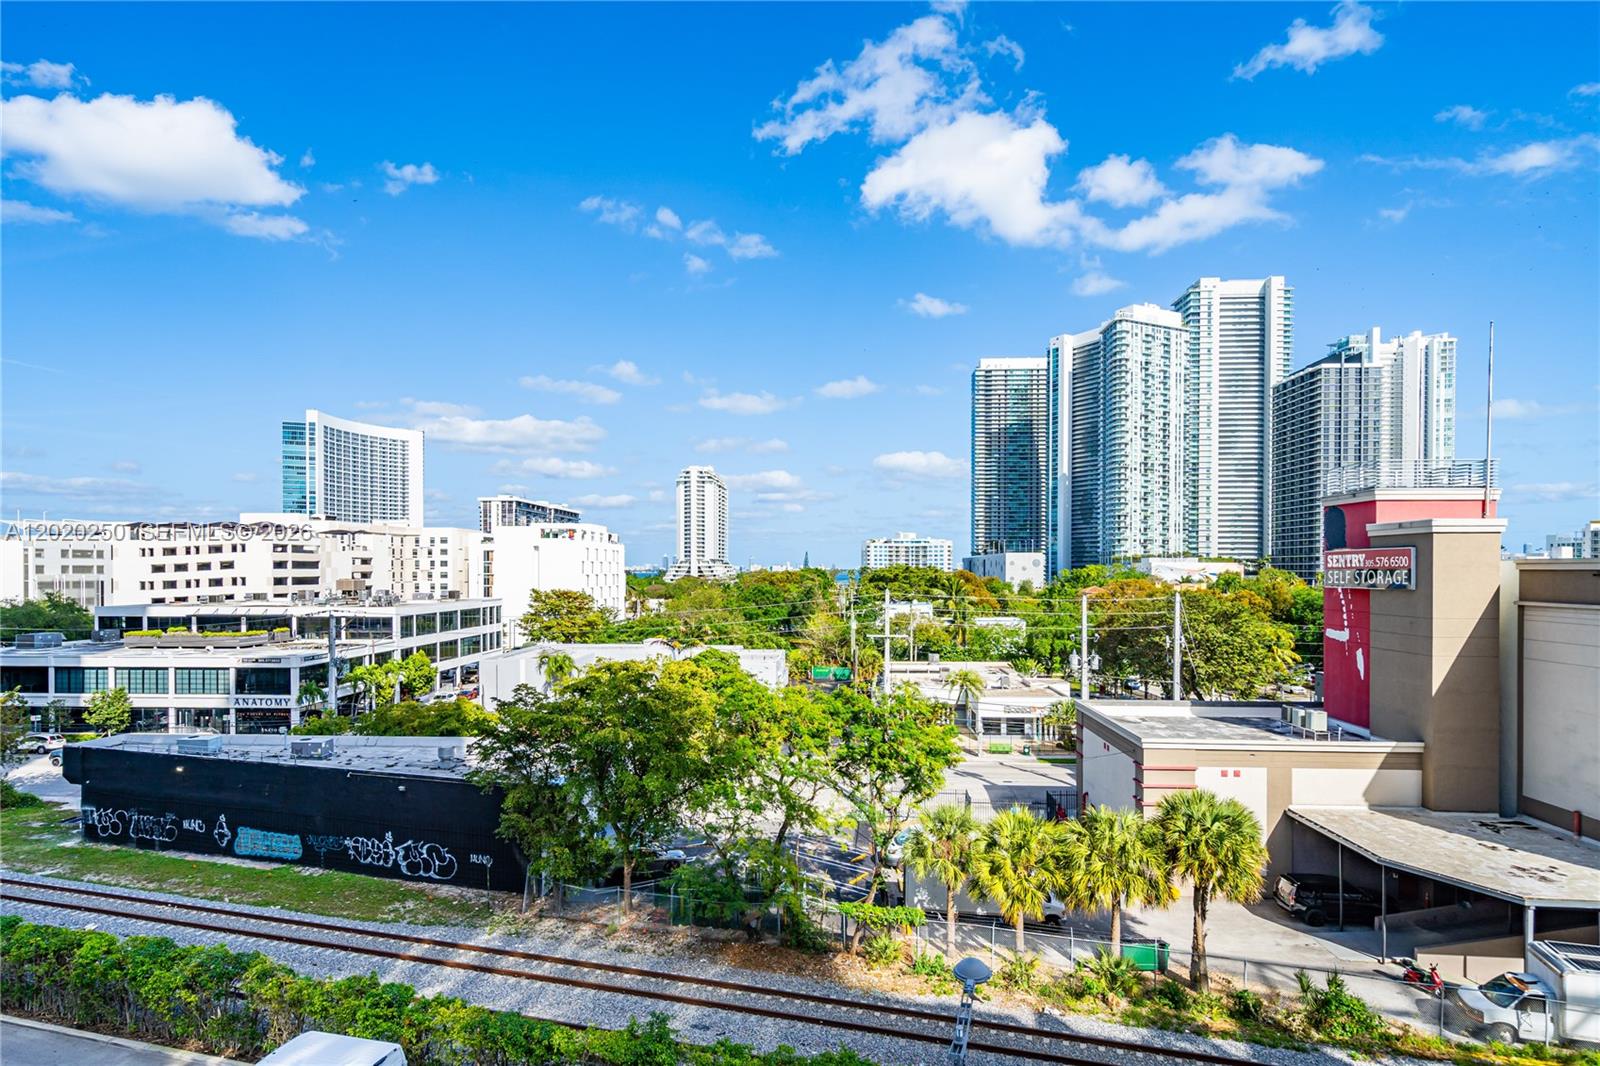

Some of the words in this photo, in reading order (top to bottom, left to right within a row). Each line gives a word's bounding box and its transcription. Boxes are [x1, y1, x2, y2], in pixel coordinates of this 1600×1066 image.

[1327, 554, 1365, 567] SENTRY
[1327, 570, 1351, 584] SELF
[1354, 570, 1409, 585] STORAGE
[234, 698, 290, 706] ANATOMY
